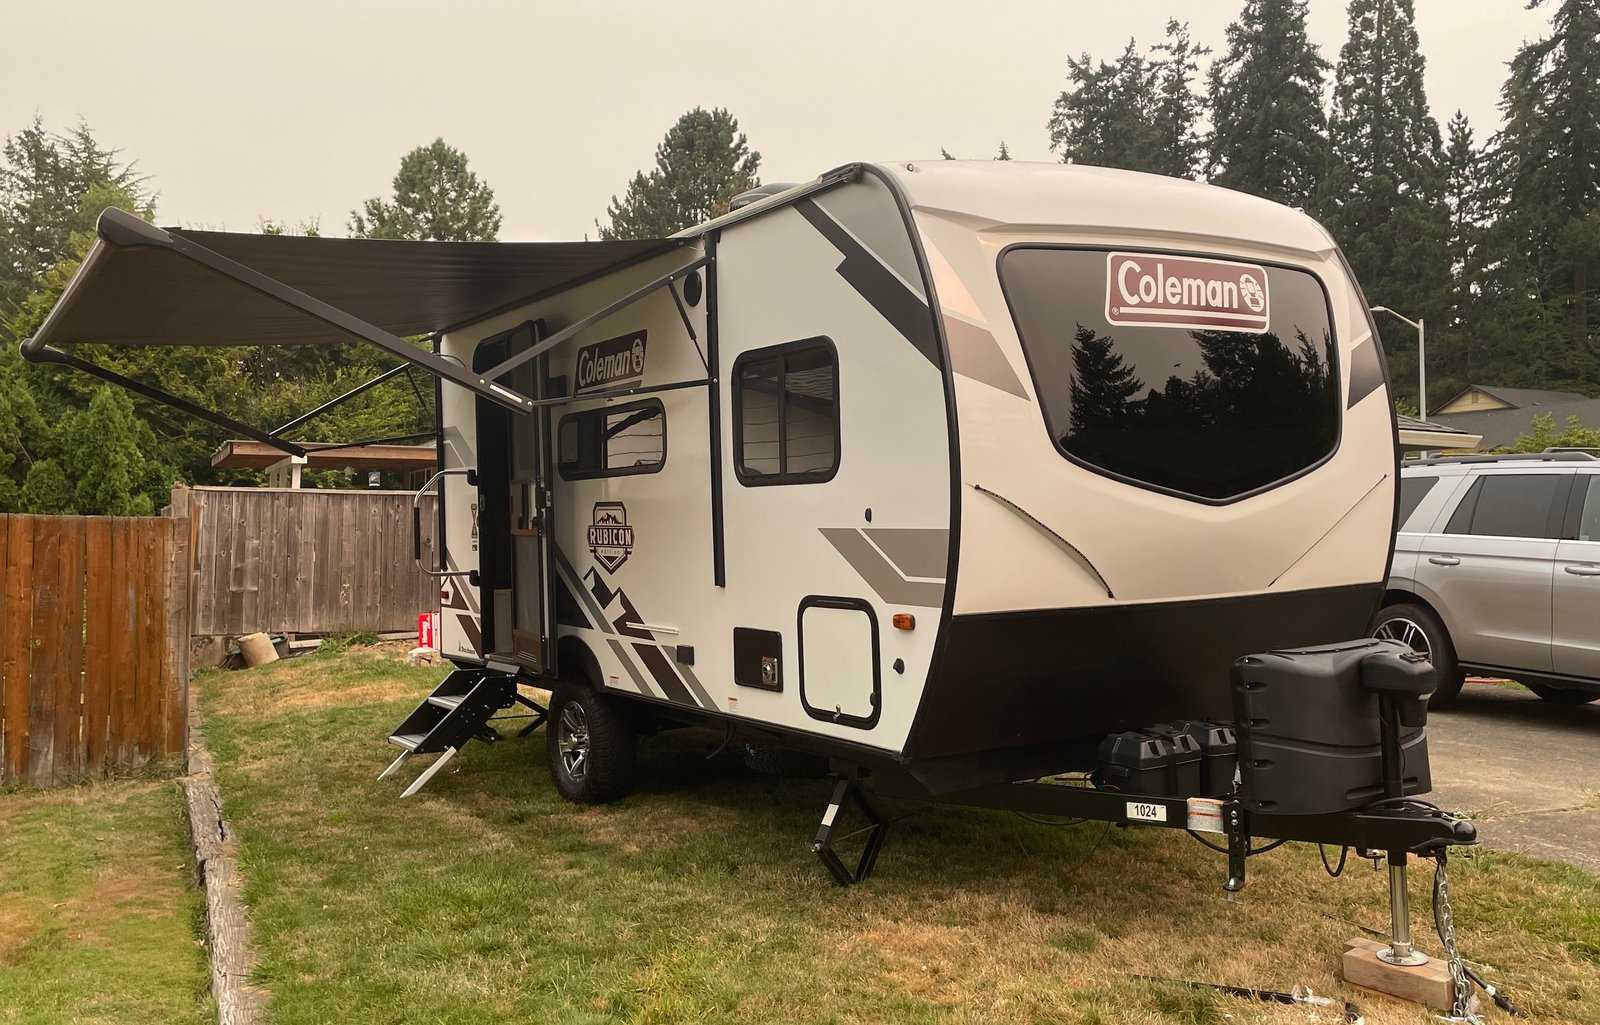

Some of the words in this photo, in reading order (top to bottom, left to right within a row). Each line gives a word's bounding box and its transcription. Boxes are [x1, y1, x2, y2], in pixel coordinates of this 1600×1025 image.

[1118, 260, 1238, 309] Coleman
[579, 347, 631, 387] Coleman
[589, 528, 632, 546] RUBICON
[1134, 804, 1157, 818] 1024
